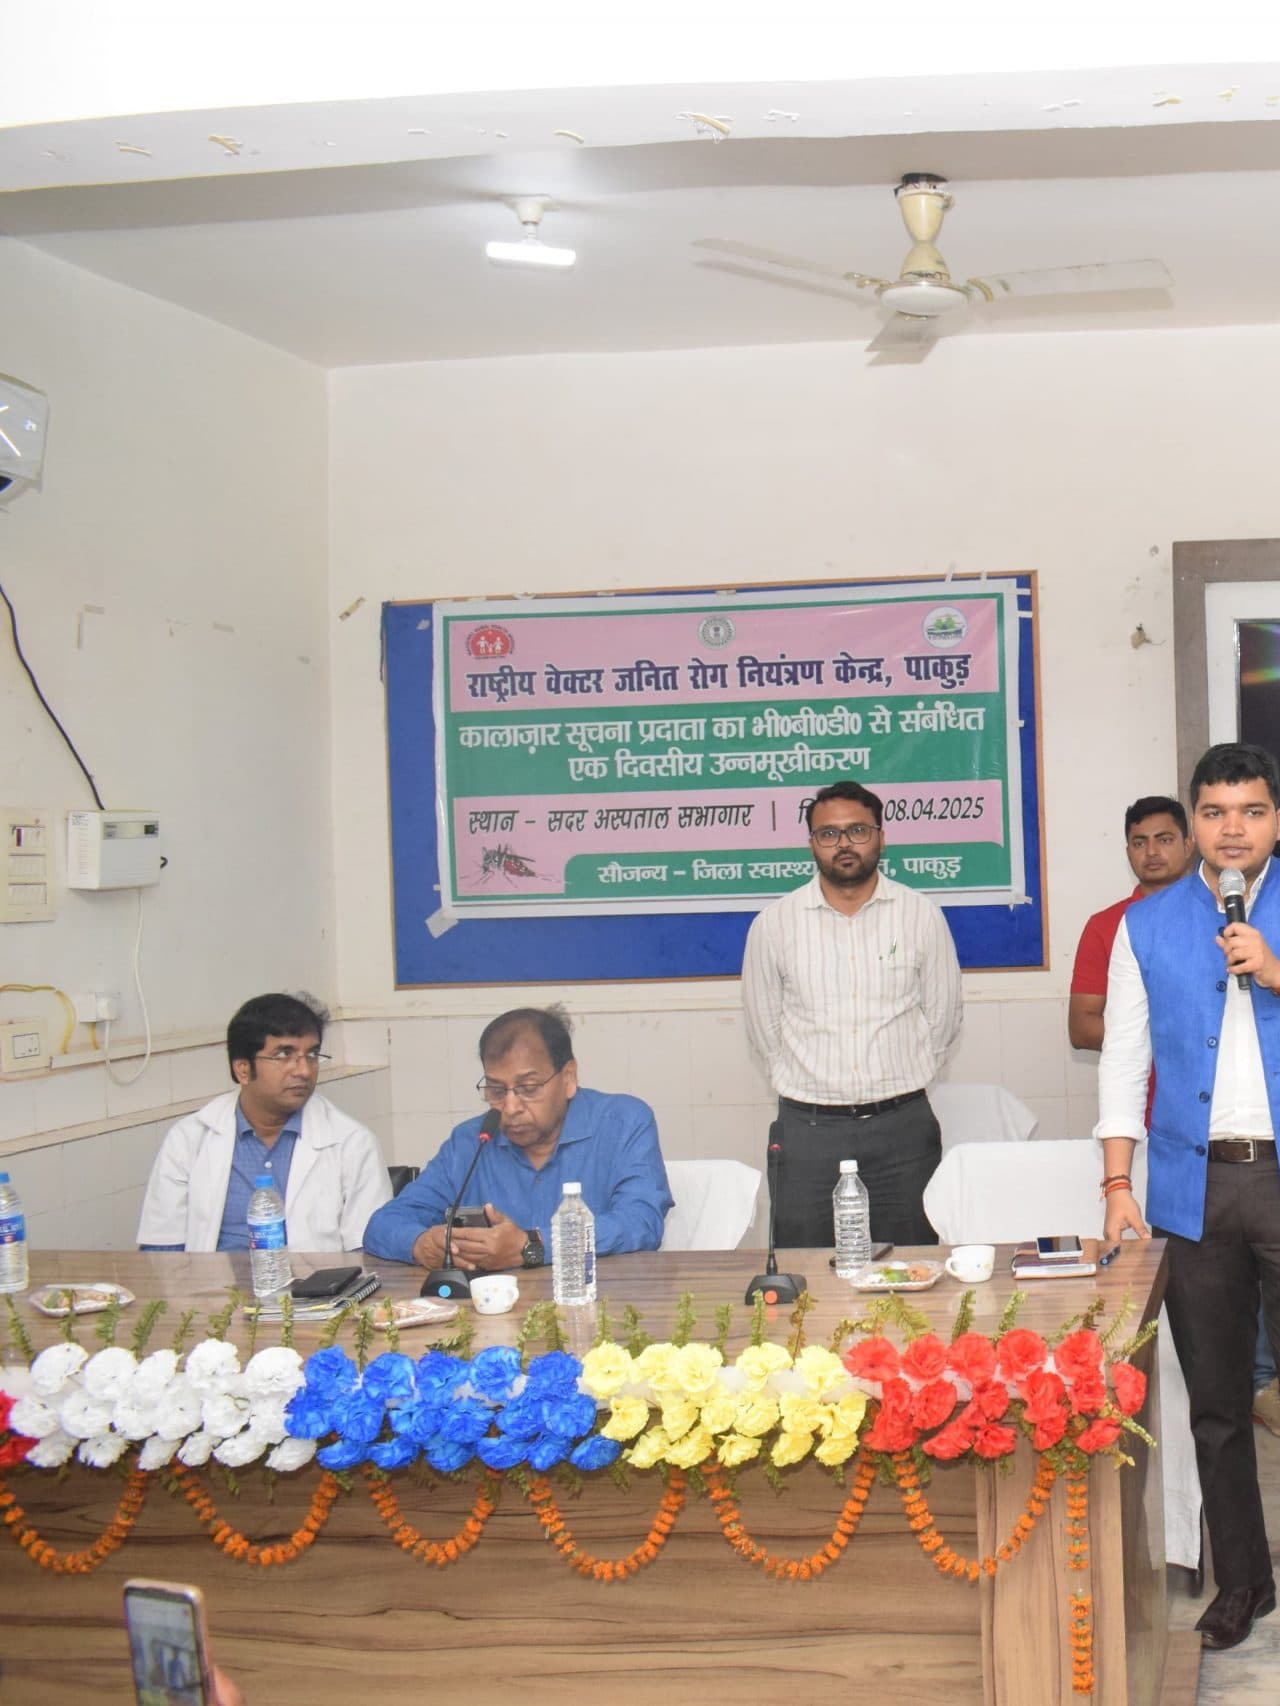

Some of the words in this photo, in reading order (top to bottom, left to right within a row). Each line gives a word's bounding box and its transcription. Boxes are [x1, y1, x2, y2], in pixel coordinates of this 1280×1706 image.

[466, 665, 537, 703] राष्ट्रीय
[545, 663, 604, 694] वेक्टर
[612, 660, 680, 692] जनित
[688, 657, 728, 689] रोग
[737, 653, 824, 688] नियंत्रण
[833, 652, 892, 688] केन्द्र,
[904, 654, 971, 689] पाकुड़
[459, 723, 561, 755] कालाज़ार
[565, 720, 632, 753] सूचना
[638, 718, 707, 745] प्रदाता
[712, 716, 746, 740] का
[868, 705, 892, 734] से
[898, 701, 986, 733] संबंधित
[568, 757, 609, 782] एक
[614, 747, 703, 778] दिवसीय
[709, 742, 871, 782] उन्नमूखीकरण
[468, 809, 519, 834] स्थान
[548, 809, 588, 832] सदर
[594, 807, 672, 831] अस्पताल
[677, 803, 755, 828] सभागार
[884, 796, 984, 821] 08.04.2025
[693, 859, 742, 880] जिला
[747, 861, 818, 879] स्वास्थ्य
[902, 856, 963, 880] पाकुड़
